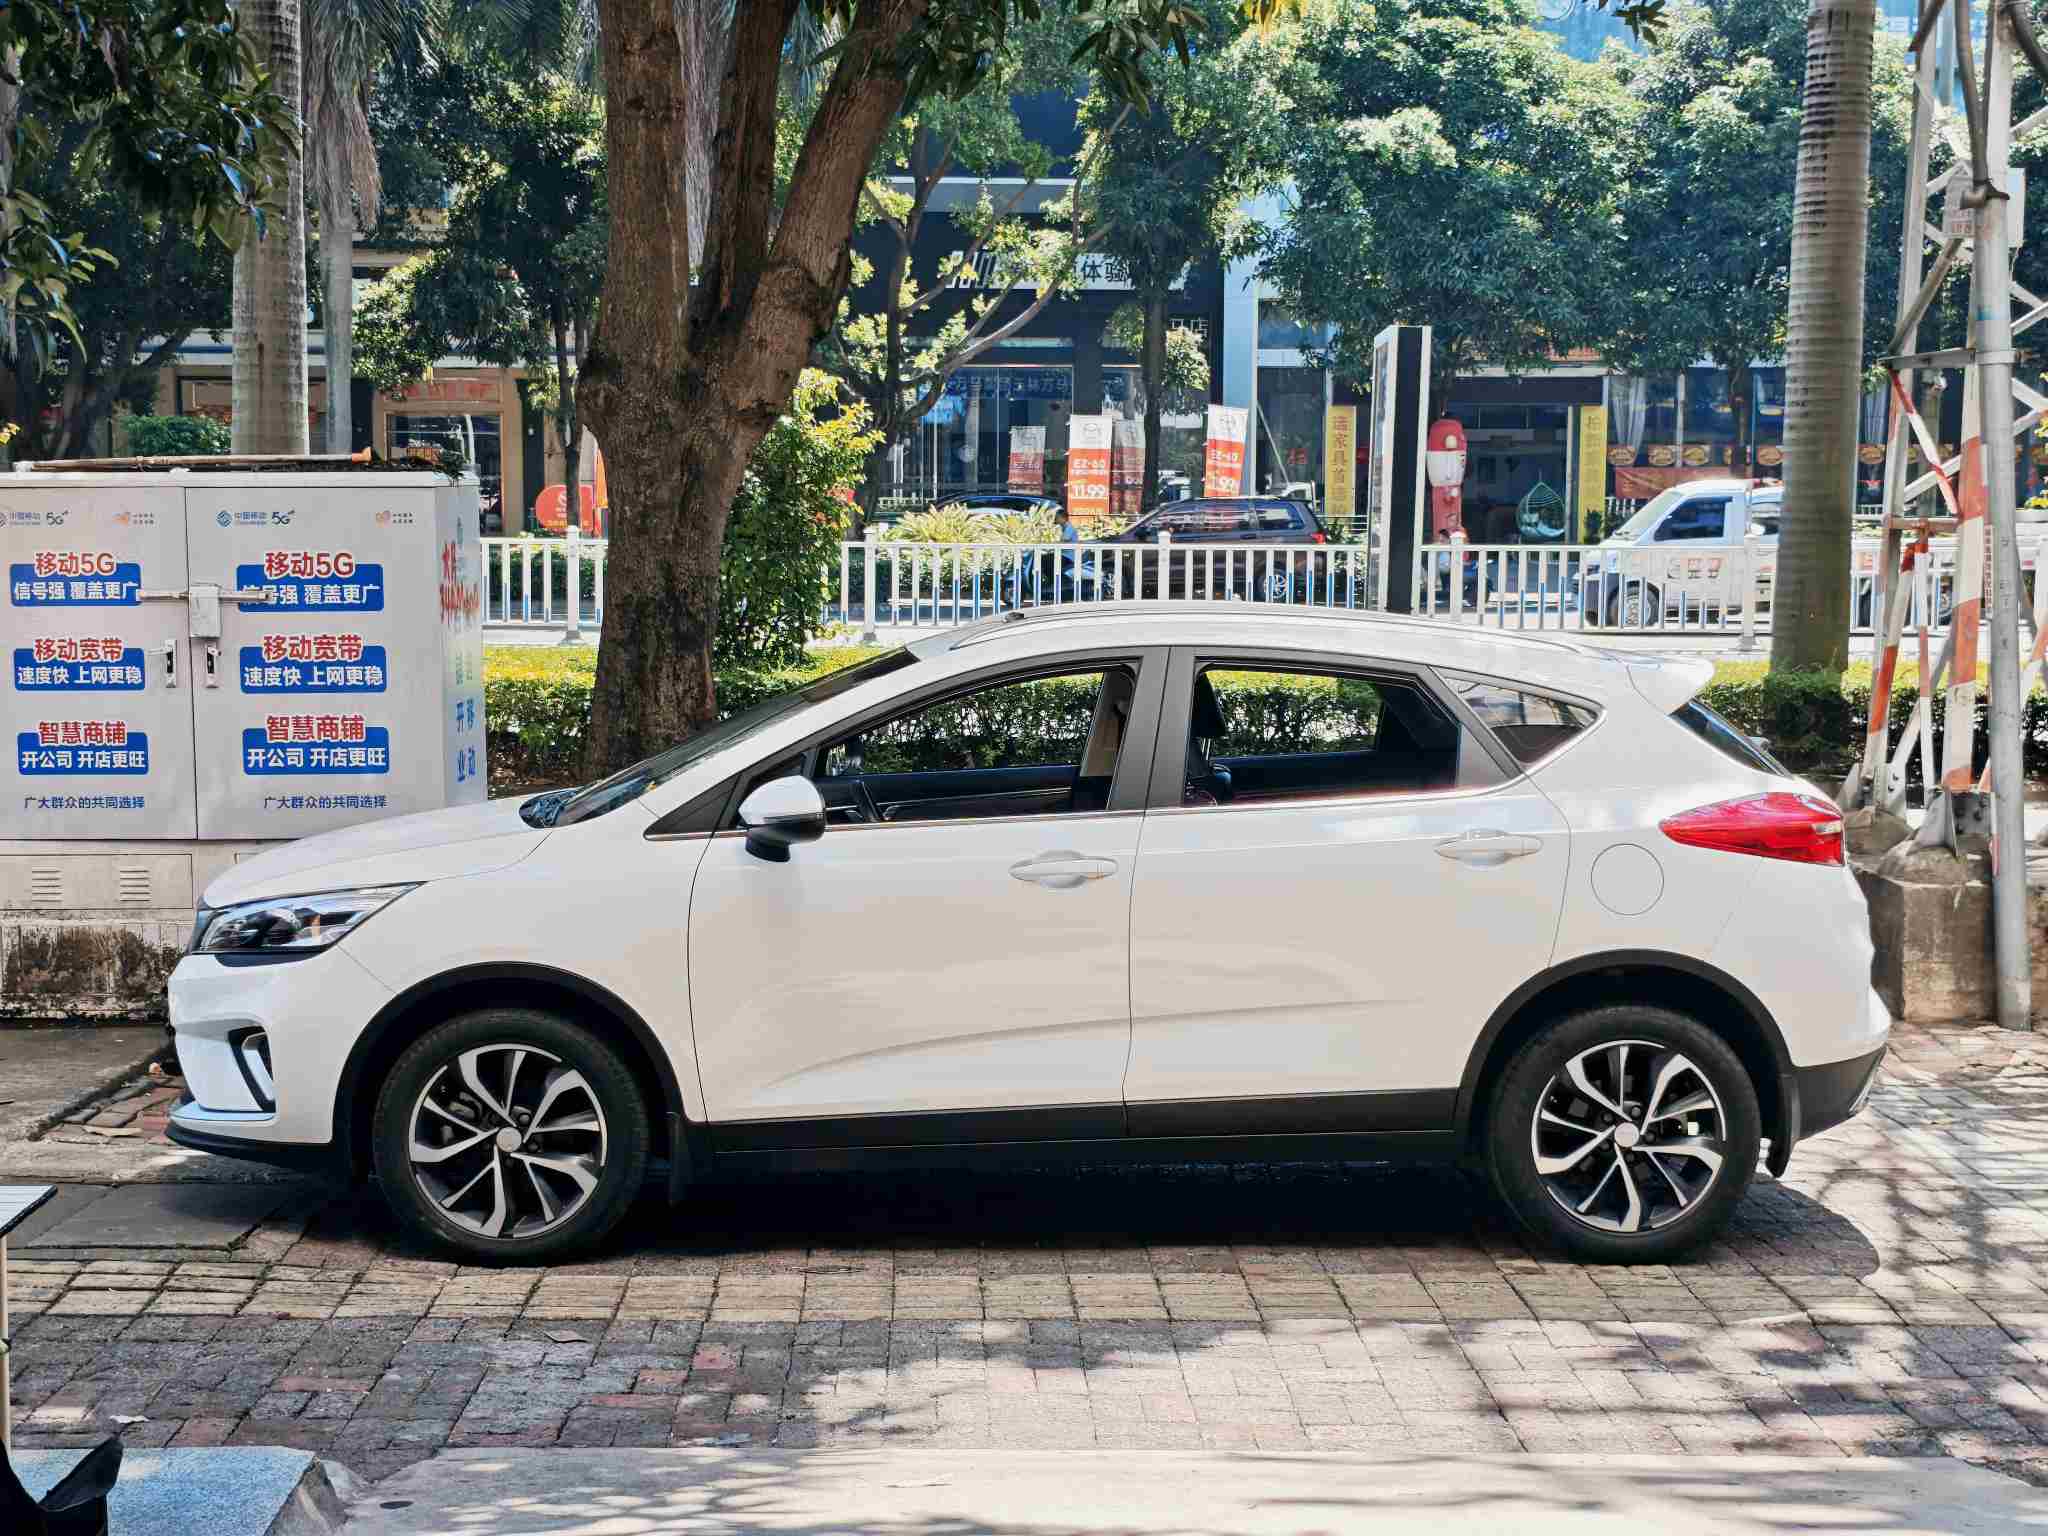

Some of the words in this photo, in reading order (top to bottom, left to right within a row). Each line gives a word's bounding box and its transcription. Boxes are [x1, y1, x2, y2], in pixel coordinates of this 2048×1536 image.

[35, 552, 114, 576] 移动5G
[265, 551, 354, 577] 移动5G
[15, 582, 66, 600] 信号强
[70, 581, 139, 600] 覆盖更广
[303, 584, 380, 605] 覆盖更广
[35, 637, 122, 661] 移动宽带
[263, 634, 362, 661] 移动宽带
[18, 666, 69, 684] 速度快
[74, 666, 142, 684] 上网更稳
[244, 666, 302, 687] 速度快
[307, 666, 384, 686] 上网更稳
[38, 721, 126, 745] 智慧商铺
[266, 714, 365, 742] 智慧商铺
[22, 751, 73, 768] 开公司
[77, 751, 145, 769] 开店更旺
[247, 748, 304, 768] 开公司
[310, 747, 386, 767] 开店更旺
[24, 796, 145, 809] 广大群众的共同选择
[264, 795, 387, 809] 广大群众的共同选择
